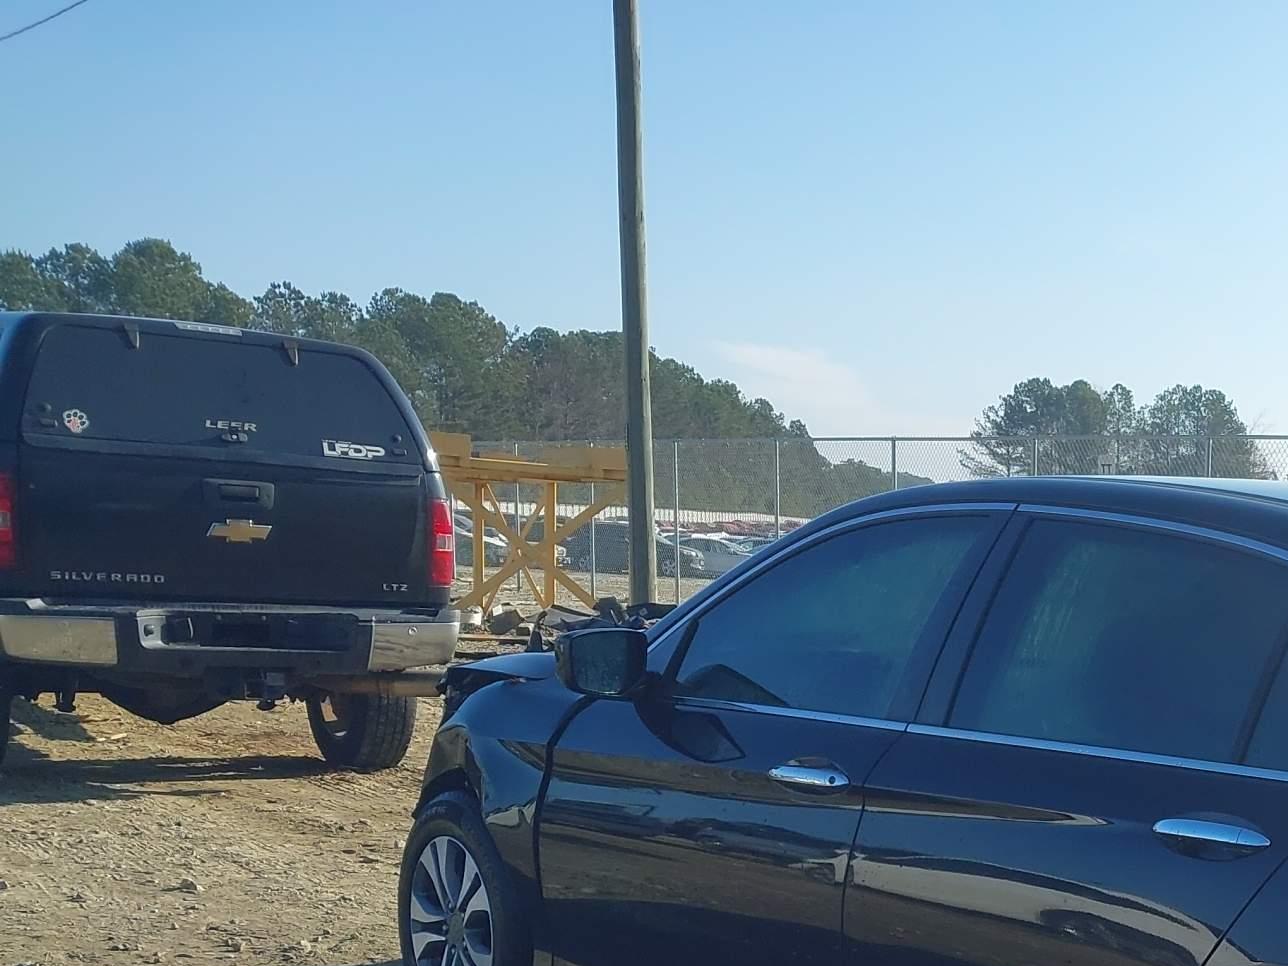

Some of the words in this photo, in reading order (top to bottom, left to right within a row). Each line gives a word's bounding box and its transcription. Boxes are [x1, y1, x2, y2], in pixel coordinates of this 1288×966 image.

[205, 419, 257, 431] LEER
[50, 570, 165, 583] SILVERADO
[382, 583, 408, 591] LTZ
